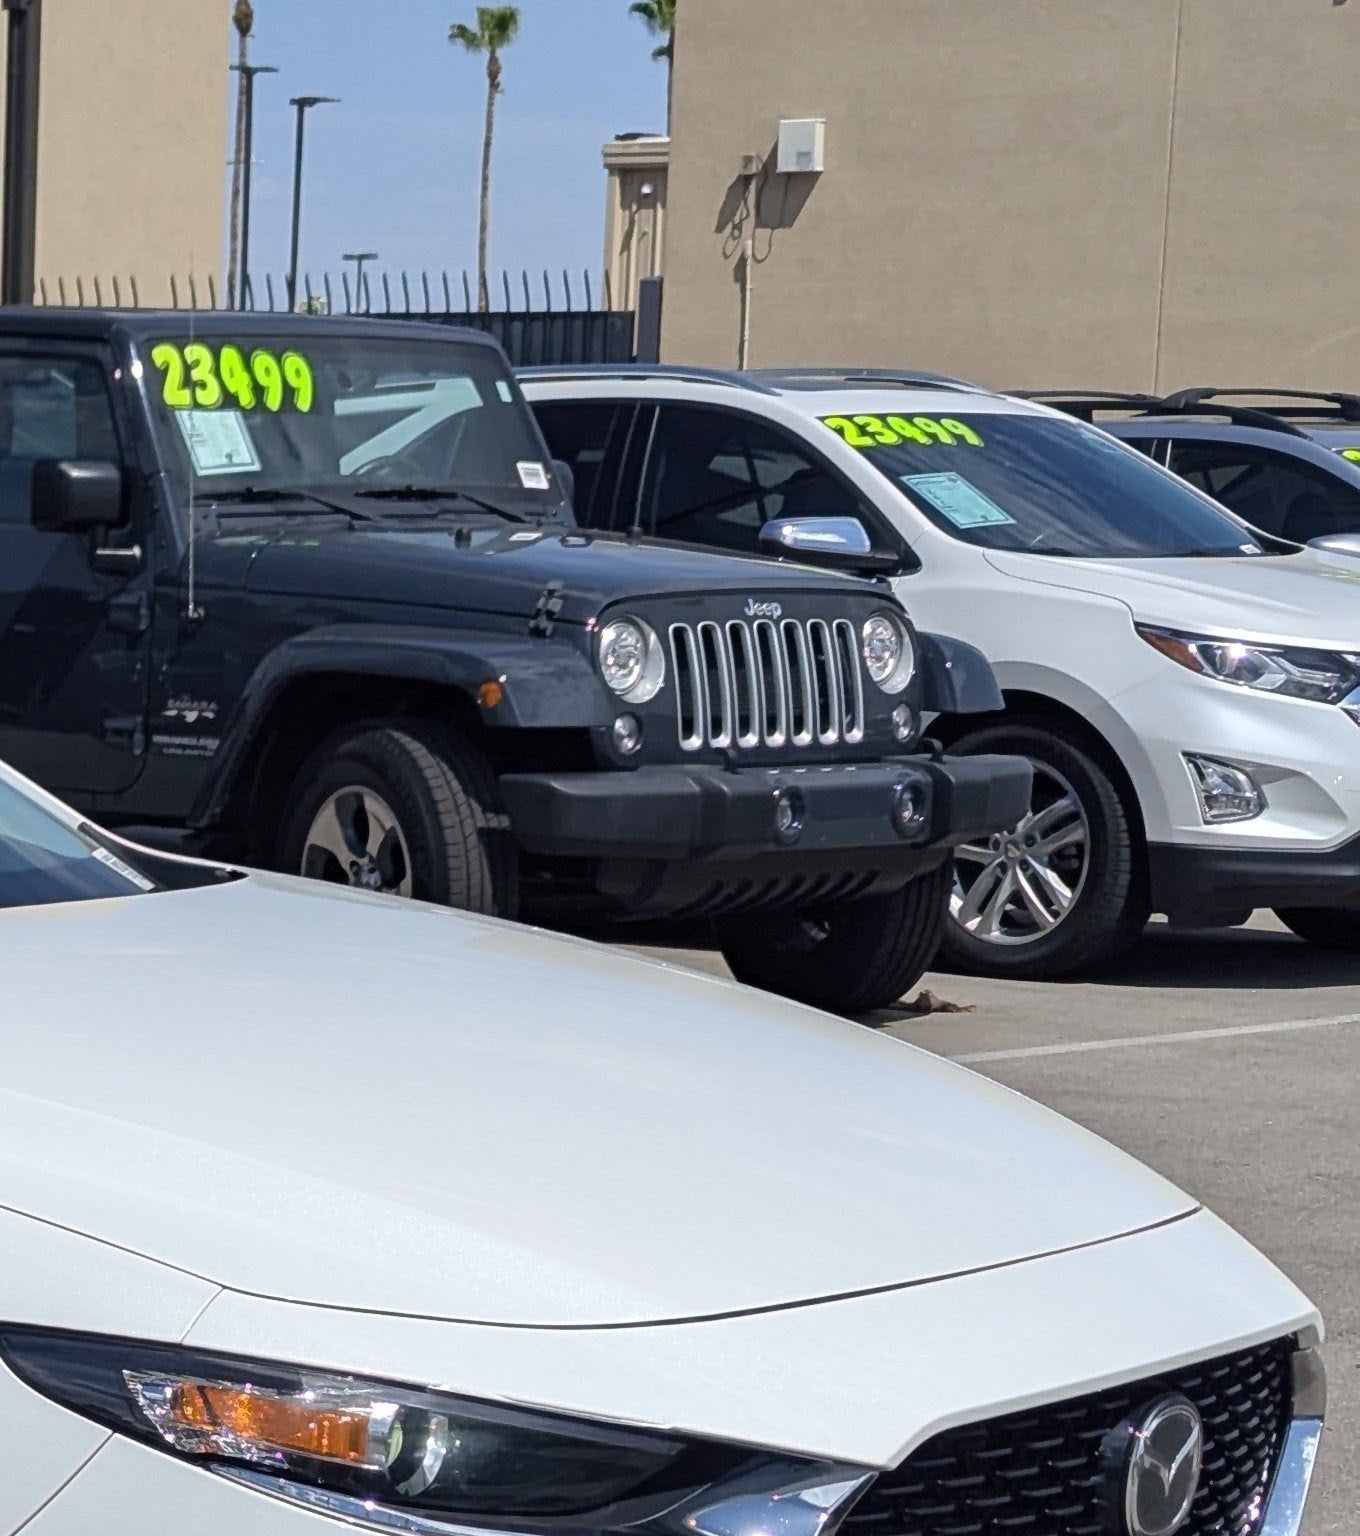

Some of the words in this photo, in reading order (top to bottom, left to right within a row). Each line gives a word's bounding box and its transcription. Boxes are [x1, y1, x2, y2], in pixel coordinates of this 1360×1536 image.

[151, 342, 313, 413] 23499
[824, 415, 985, 448] 23499
[743, 597, 782, 619] Jeep
